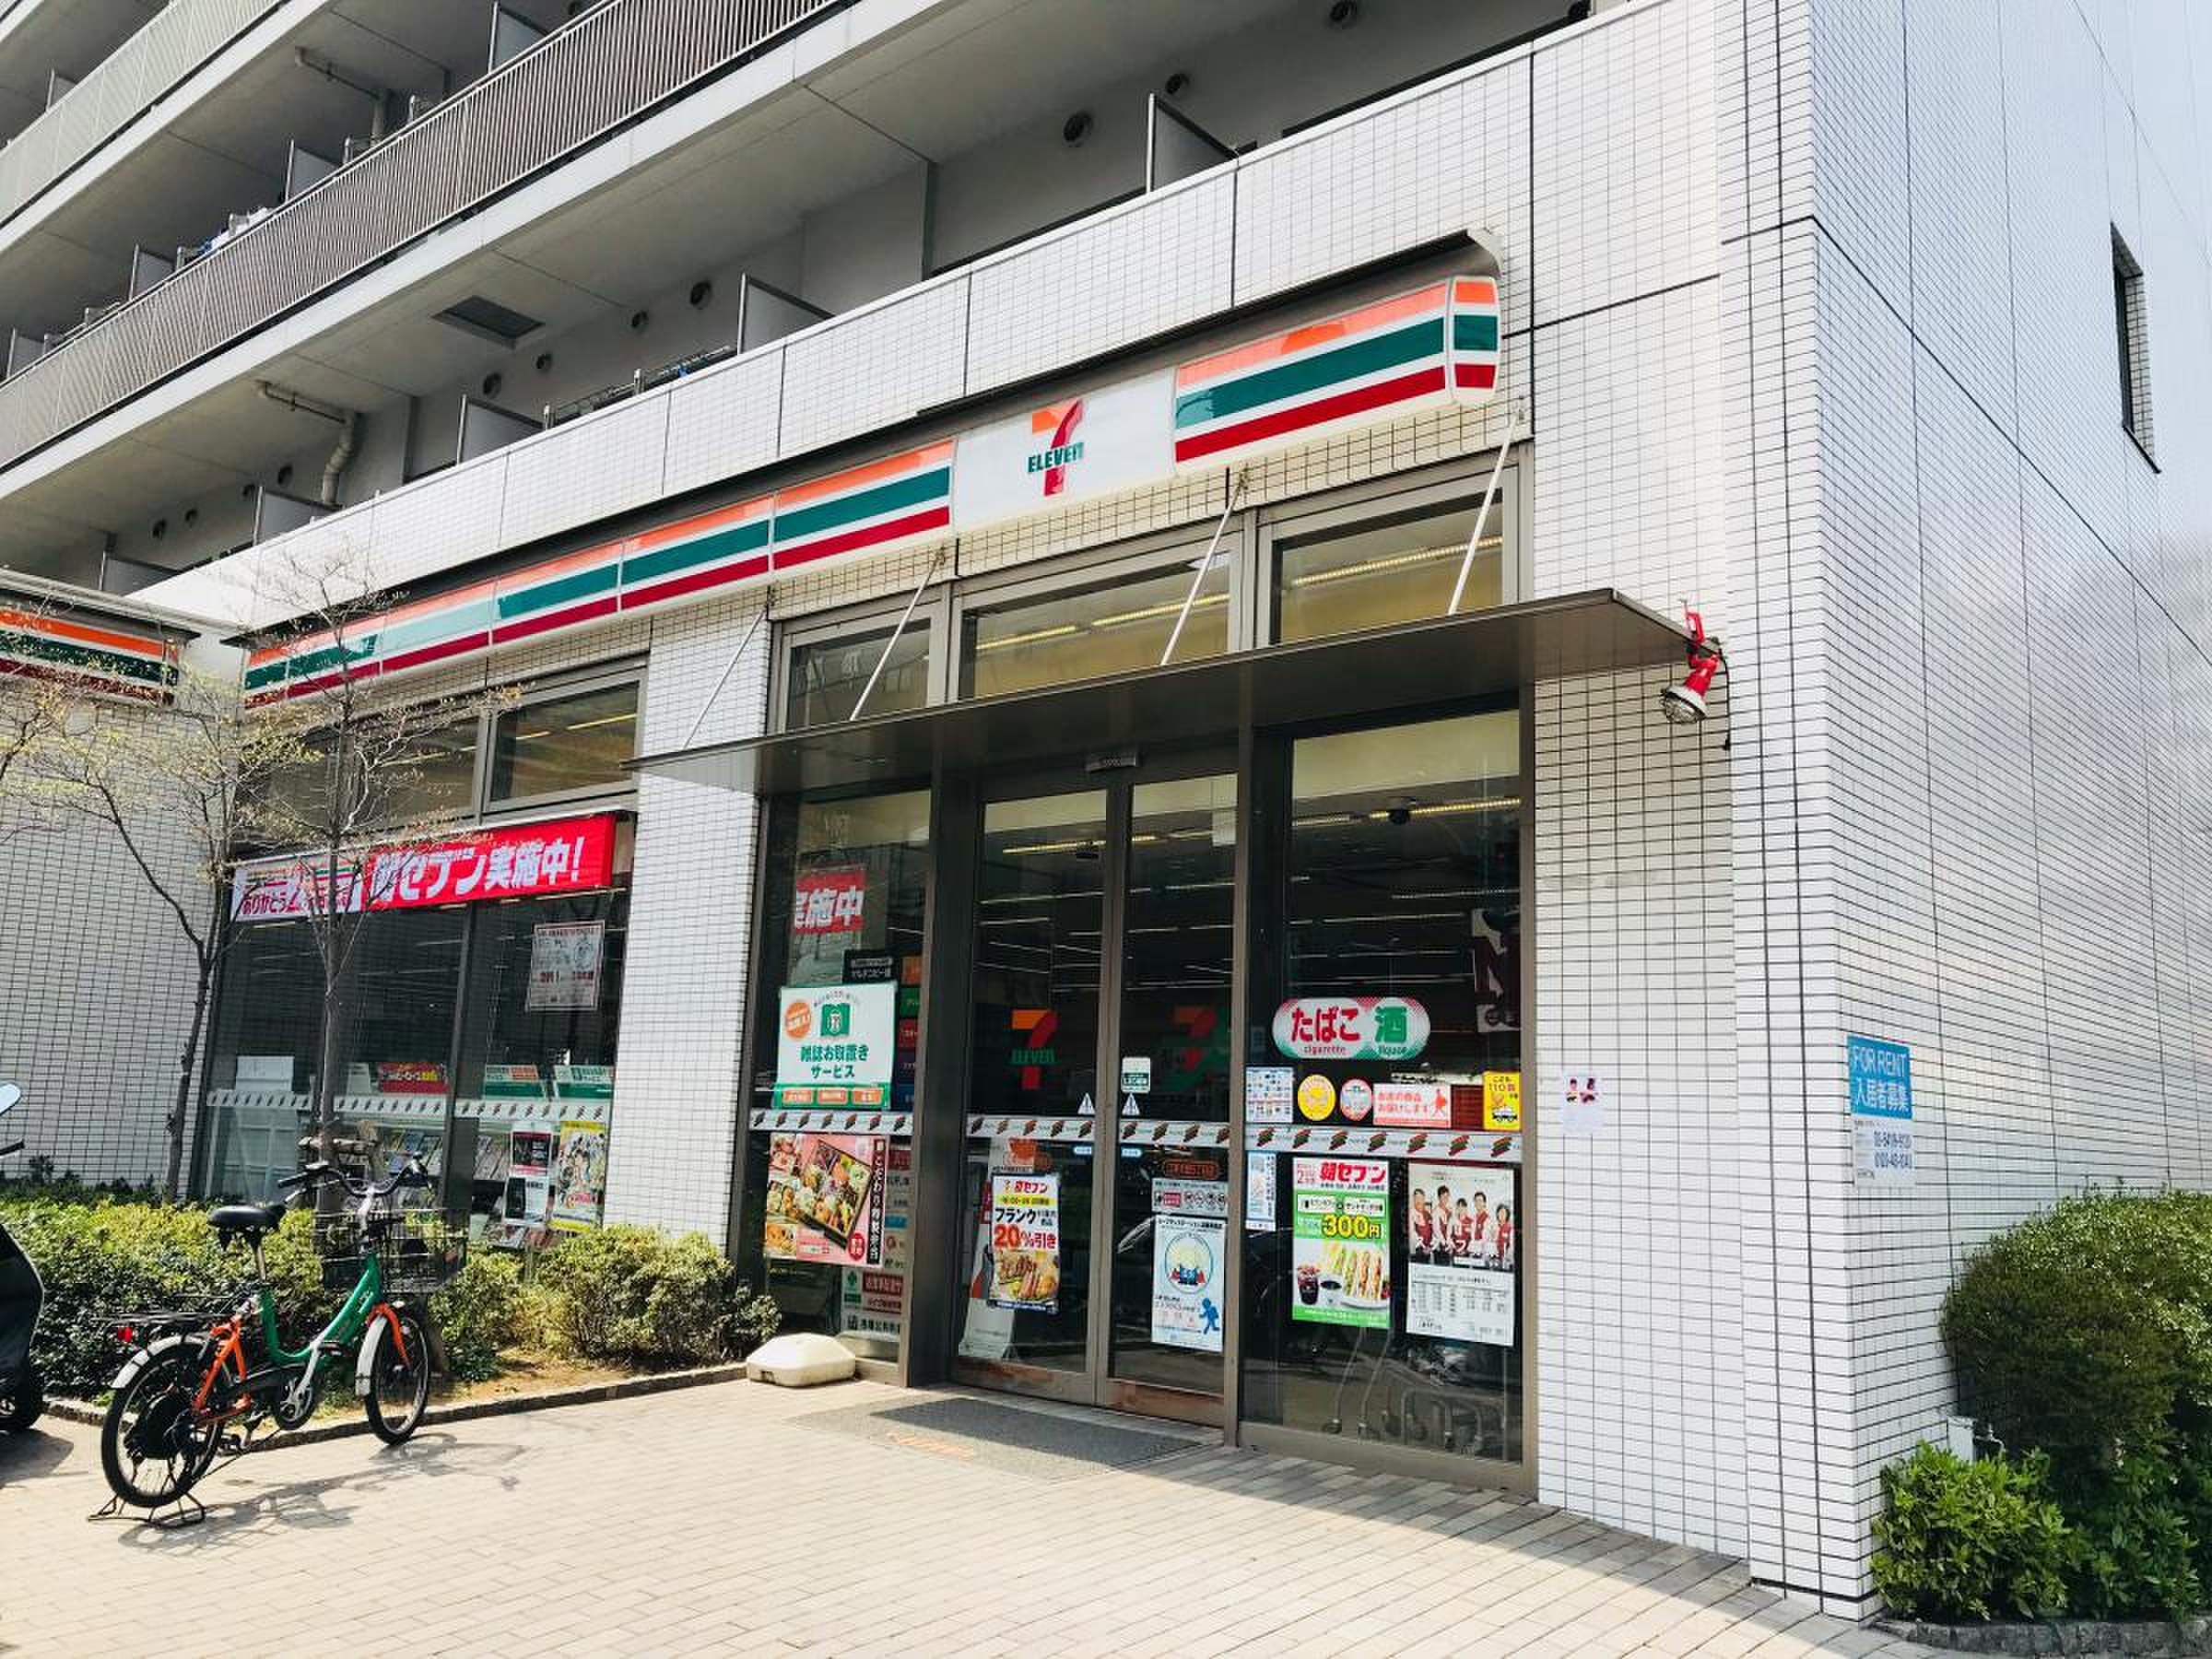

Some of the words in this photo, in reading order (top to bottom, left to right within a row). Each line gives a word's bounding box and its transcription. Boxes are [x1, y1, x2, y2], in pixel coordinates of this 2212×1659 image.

[1031, 397, 1084, 496] 7
[1291, 1006, 1361, 1042] たばこ
[1375, 1006, 1408, 1042] 酒
[811, 1065, 855, 1078] サービス
[1877, 1051, 1906, 1078] RENT
[1320, 1162, 1386, 1184] 朝セブン
[995, 1208, 1036, 1224] フランク
[1322, 1213, 1381, 1239] 300円
[994, 1224, 1056, 1250] 20%引き
